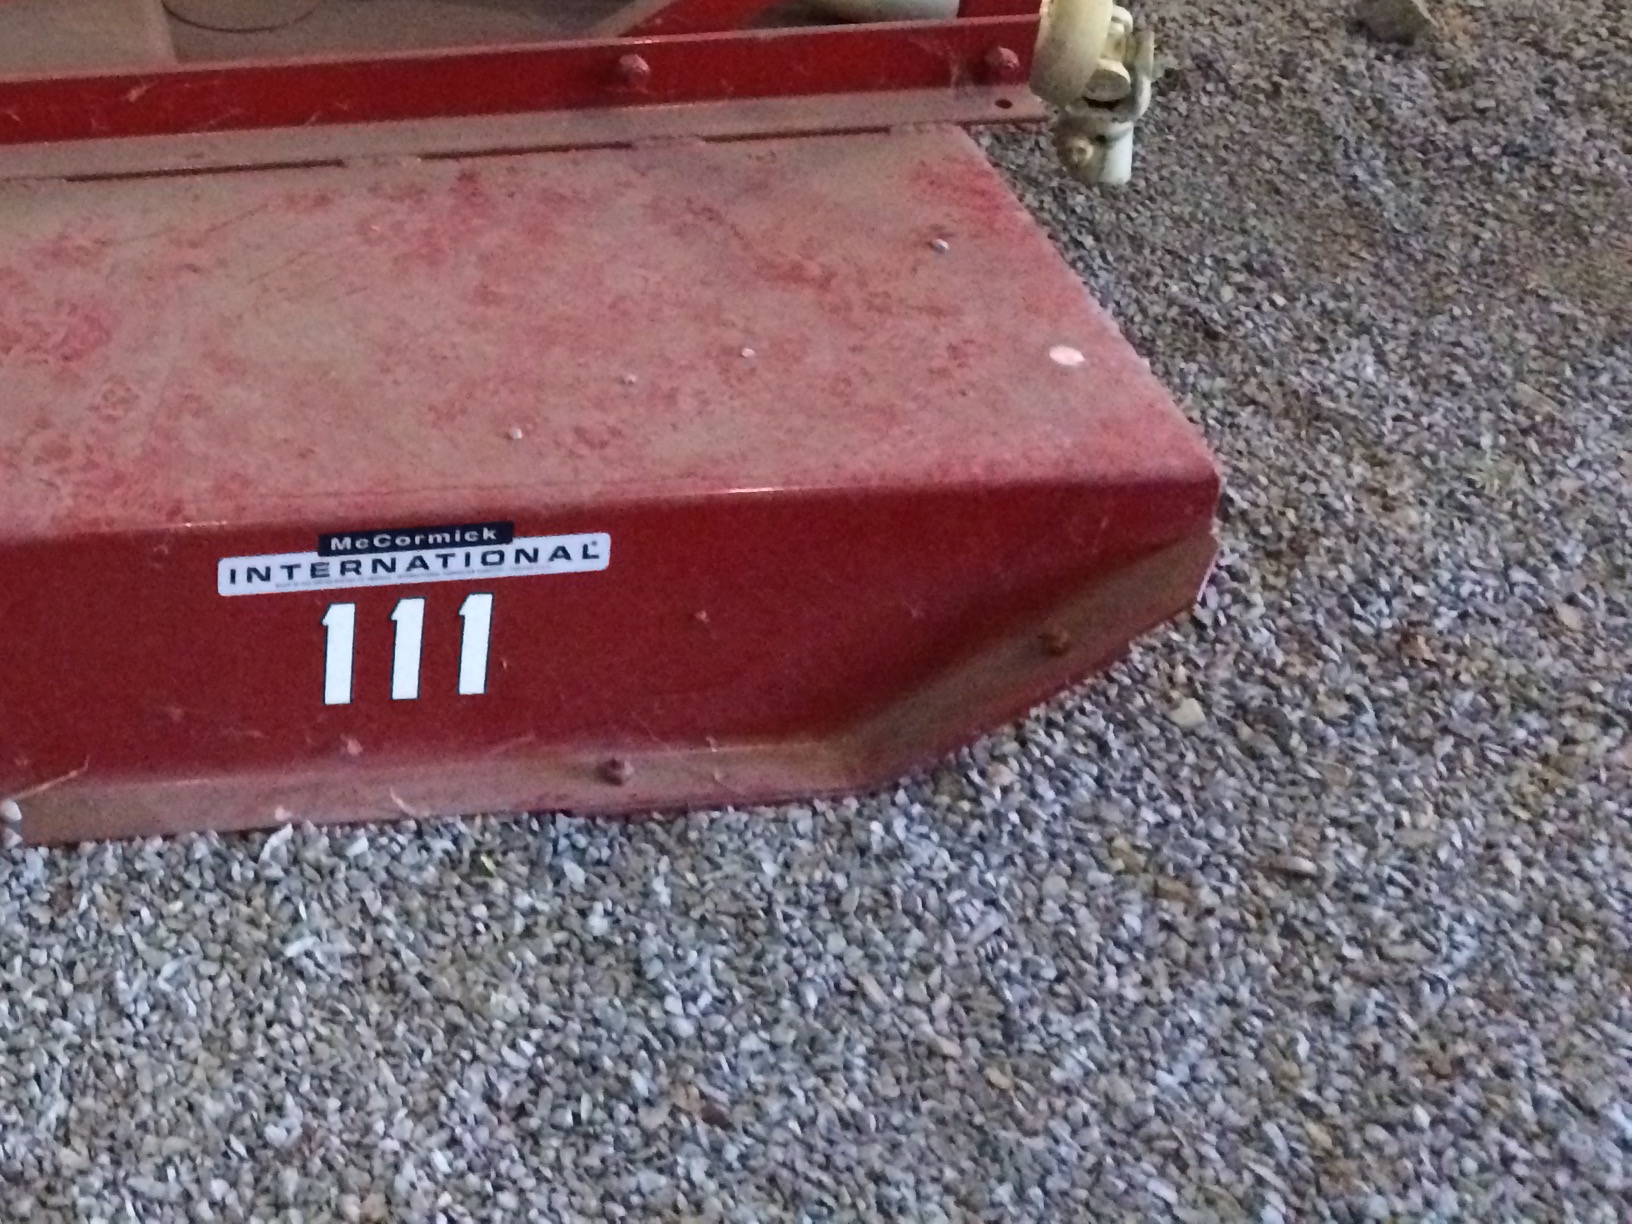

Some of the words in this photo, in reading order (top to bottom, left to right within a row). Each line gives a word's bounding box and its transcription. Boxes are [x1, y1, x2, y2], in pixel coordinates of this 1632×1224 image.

[330, 527, 498, 551] McCormick
[229, 543, 600, 585] INTERNATIONAL
[320, 591, 494, 706] 111
